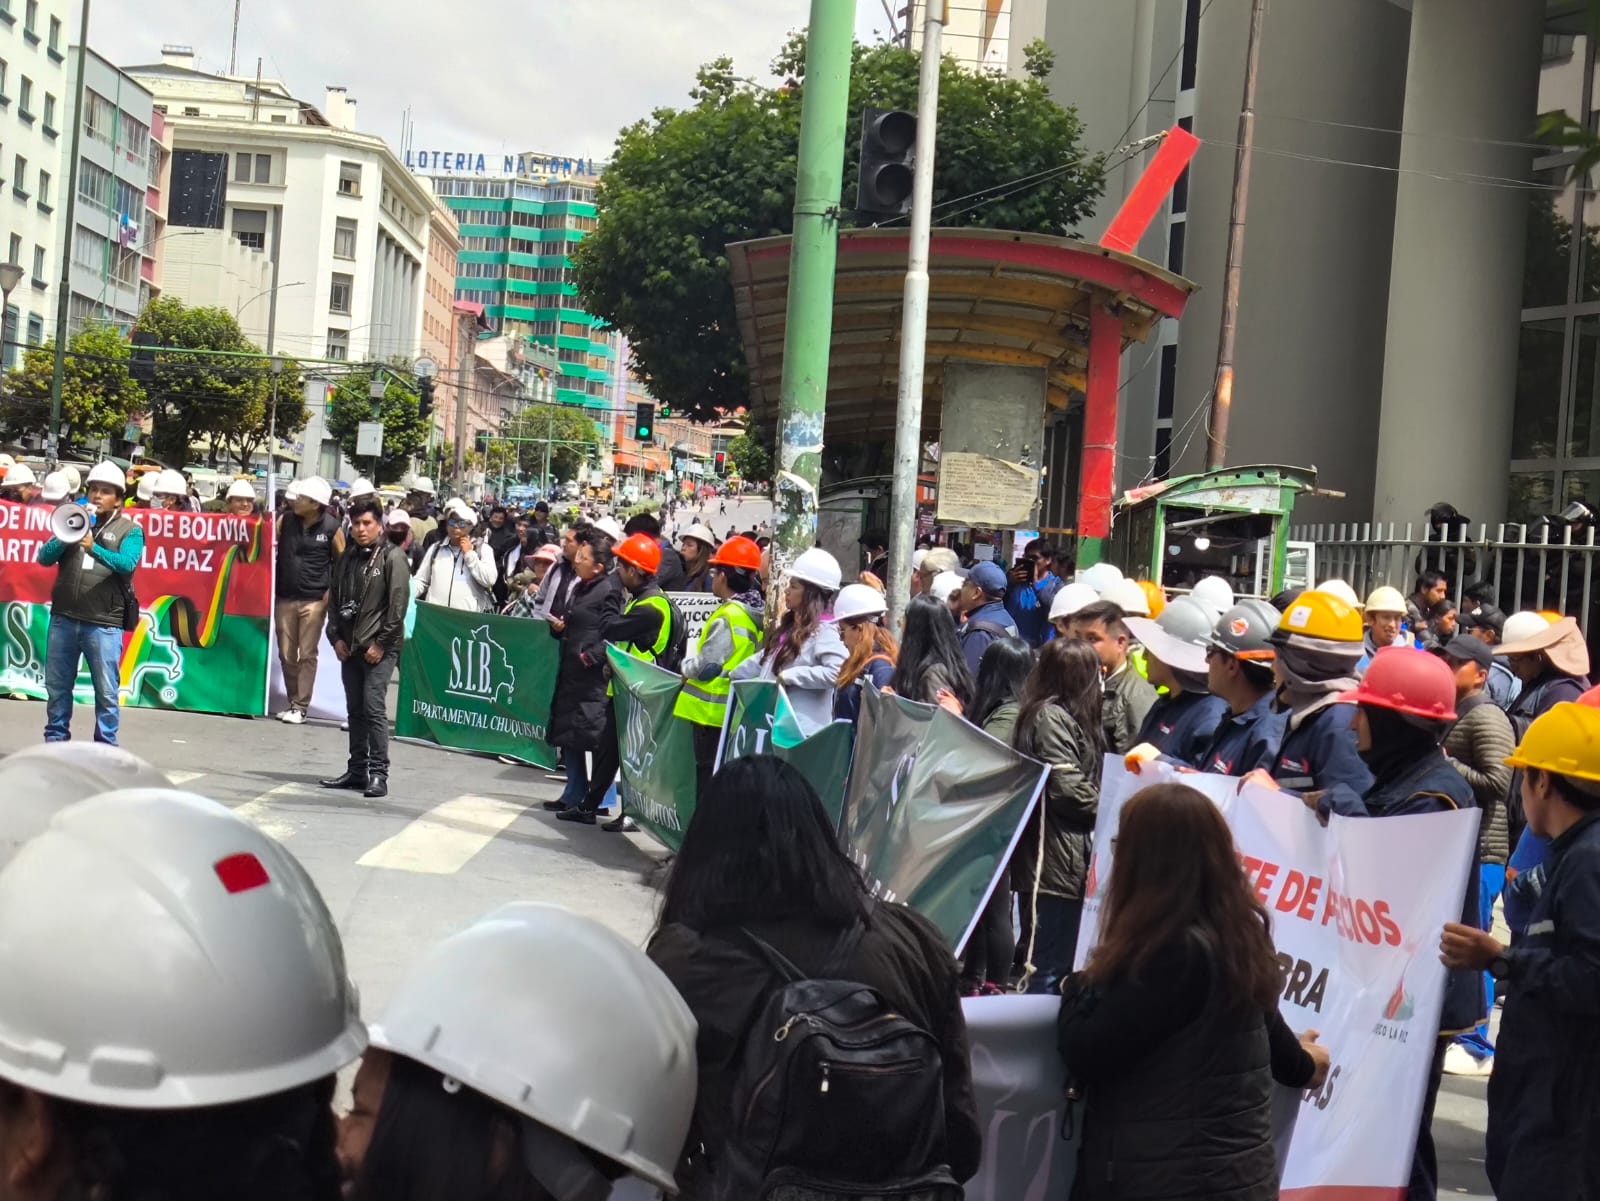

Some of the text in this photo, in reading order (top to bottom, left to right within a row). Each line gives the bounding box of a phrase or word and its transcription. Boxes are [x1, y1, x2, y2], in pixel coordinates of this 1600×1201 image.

[406, 150, 597, 176] LOTERIA NACIONAL
[149, 513, 175, 538] DE
[179, 514, 250, 542] BOLIVIA
[141, 546, 214, 572] LA PAZ
[1275, 869, 1323, 921] DE
